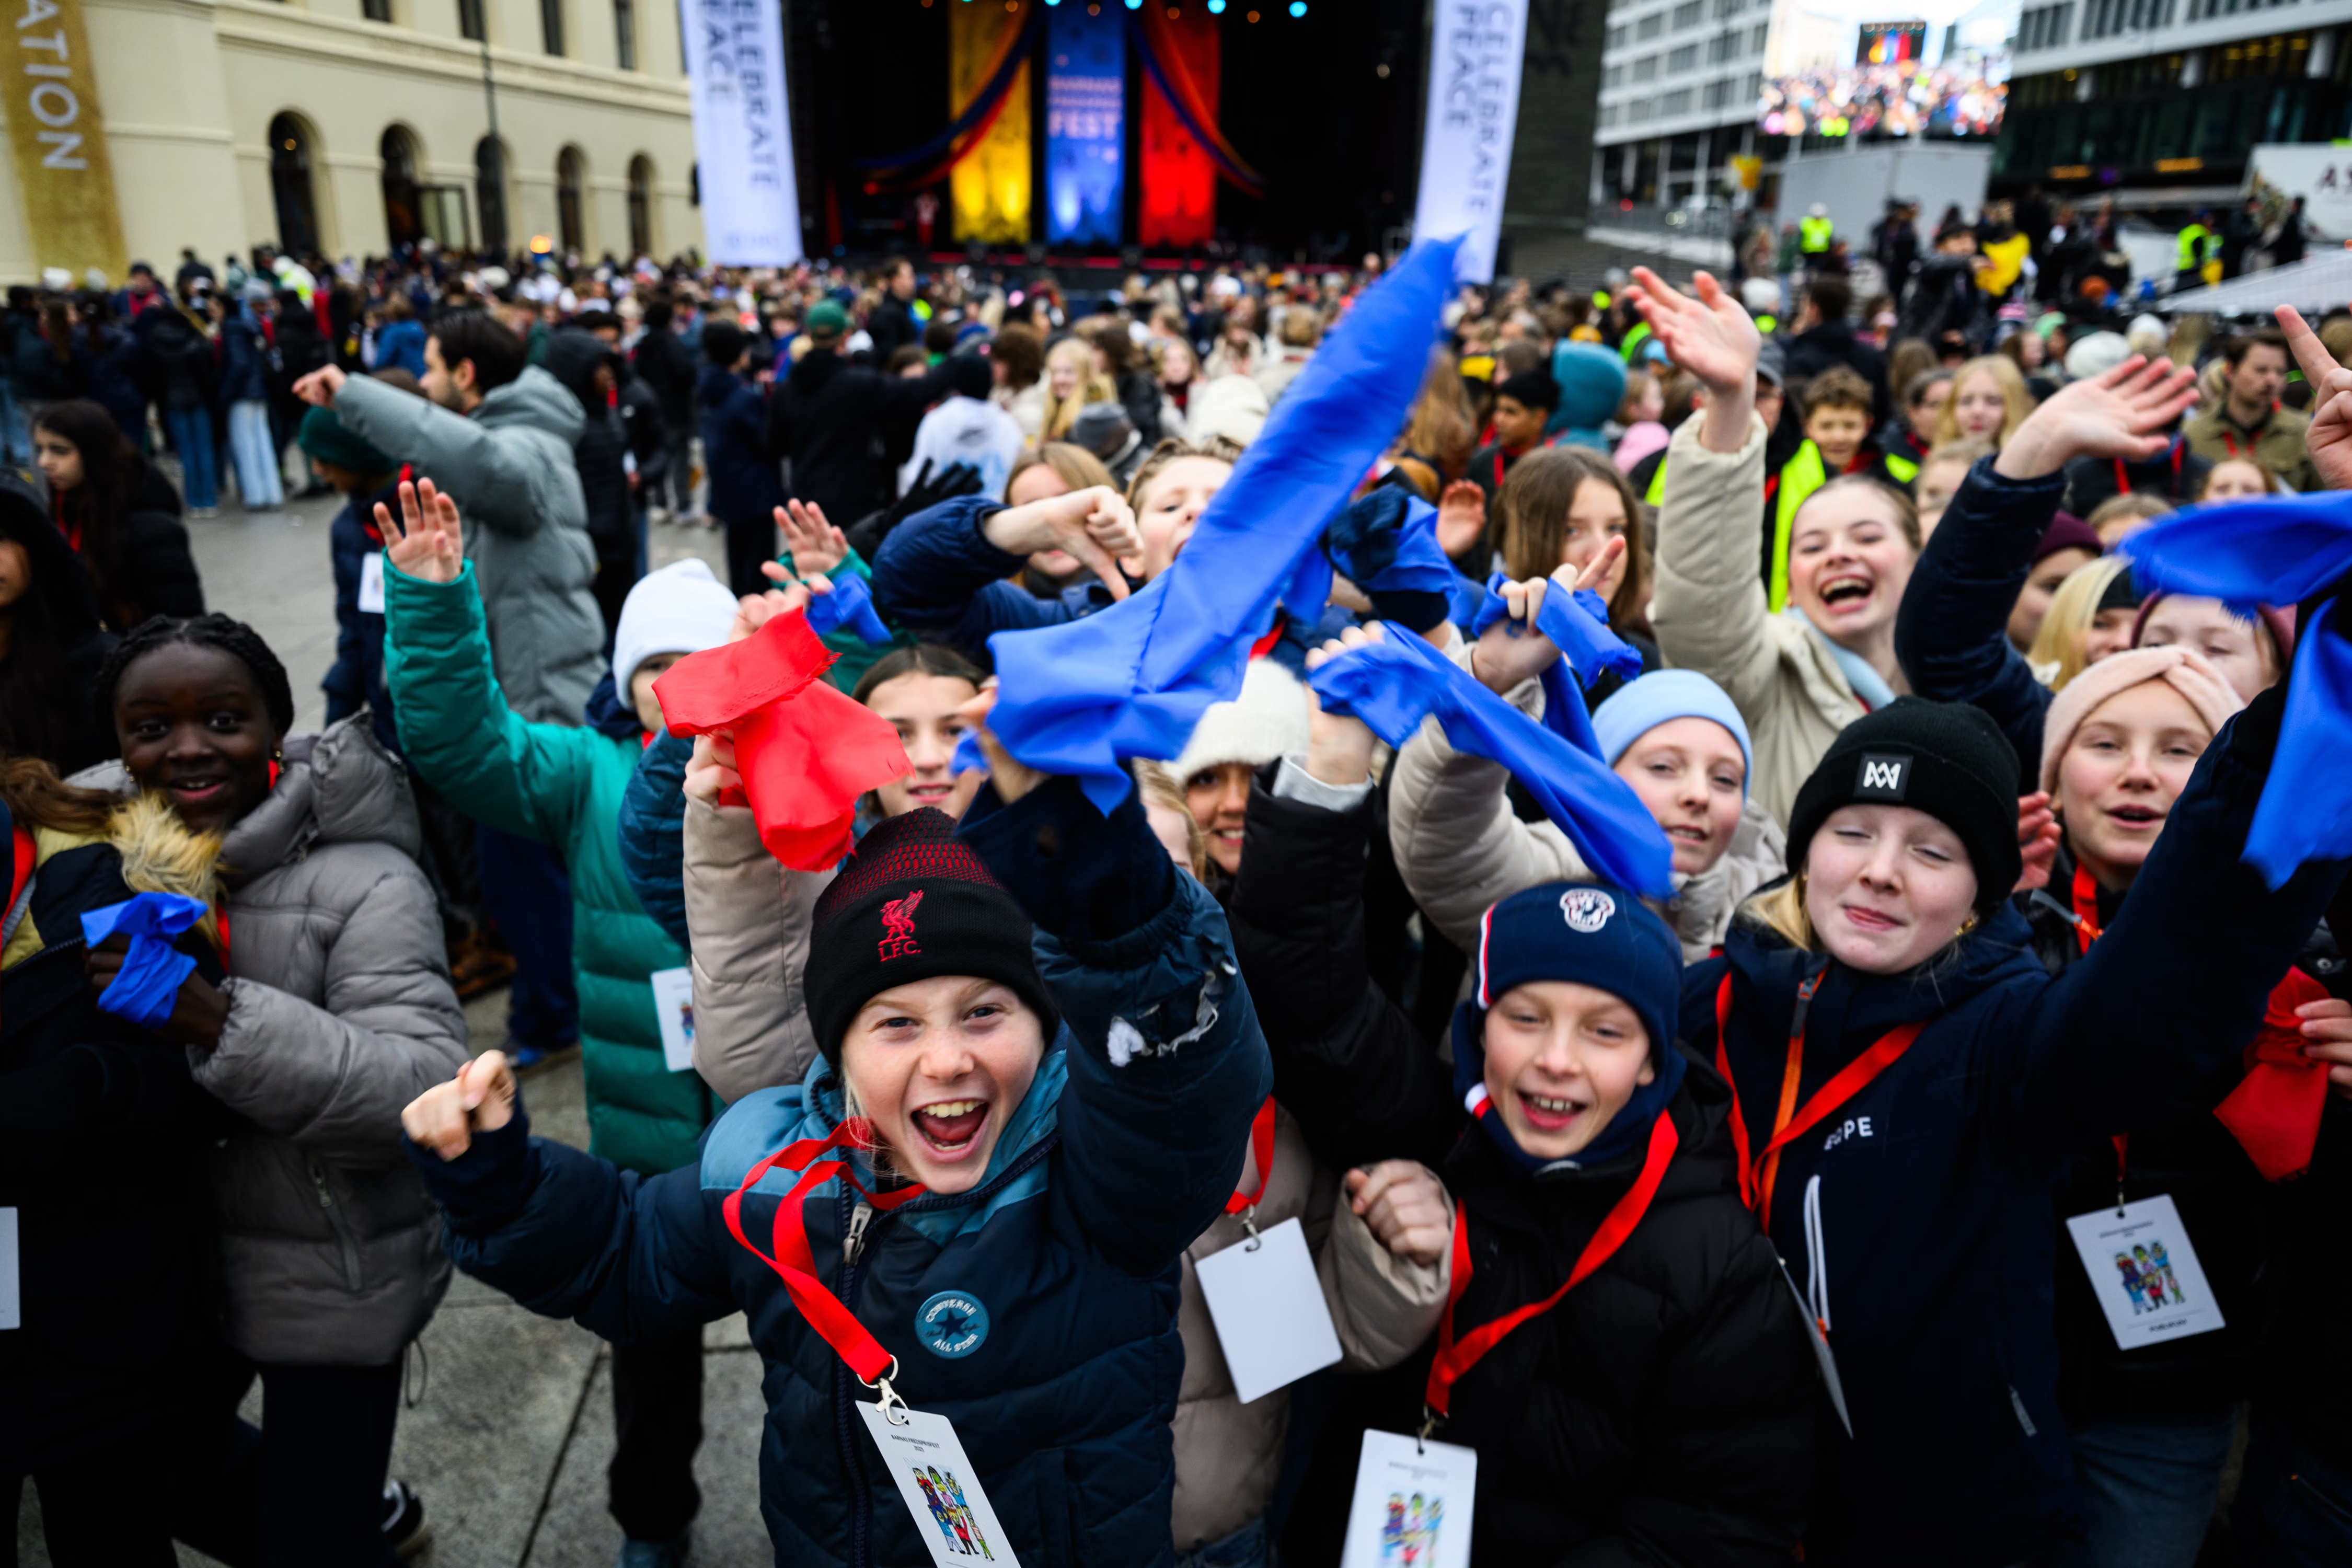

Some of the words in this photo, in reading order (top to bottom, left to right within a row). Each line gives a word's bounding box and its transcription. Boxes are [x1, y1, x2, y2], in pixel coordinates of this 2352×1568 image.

[1445, 3, 1481, 125] PEACE
[1465, 1, 1515, 213] CELEBRATE
[925, 1299, 977, 1323] CONVERSE
[932, 1339, 952, 1352] ALL
